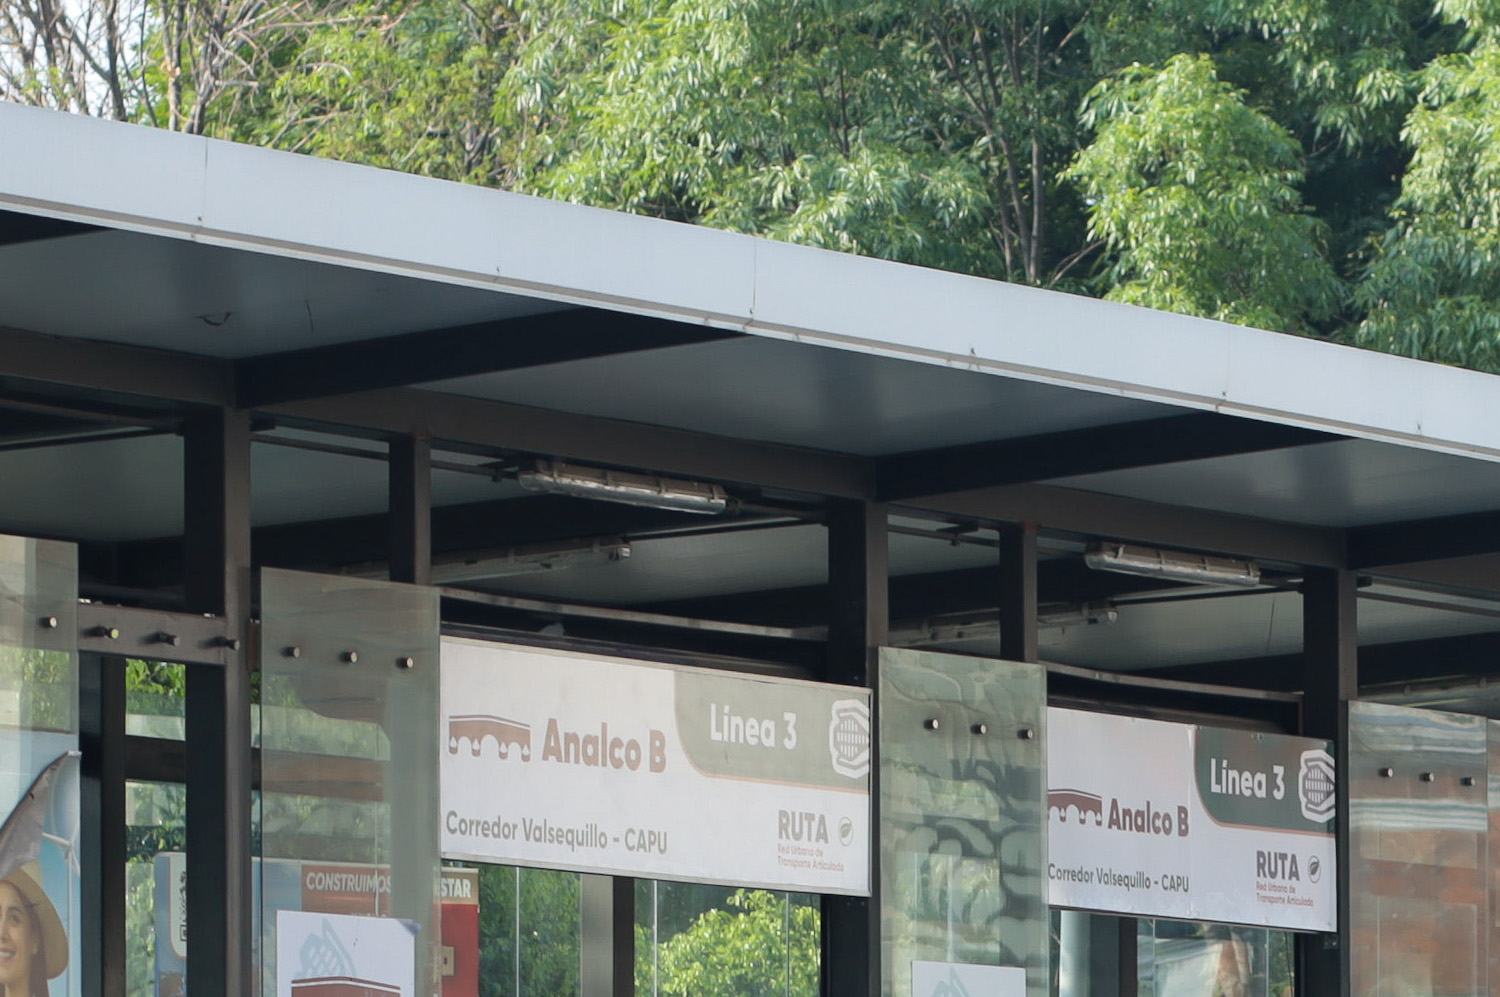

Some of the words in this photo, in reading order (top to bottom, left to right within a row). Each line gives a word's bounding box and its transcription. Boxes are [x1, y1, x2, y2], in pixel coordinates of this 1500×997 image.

[541, 718, 642, 771] Analco
[649, 729, 667, 773] B
[710, 703, 776, 748] Línea
[783, 711, 797, 749] 3
[1210, 757, 1267, 798] Línea
[1272, 764, 1285, 800] 3
[446, 809, 518, 840] Corredor
[522, 817, 608, 852] Valsequillo
[625, 827, 668, 854] CAPU
[778, 809, 829, 844] RUTA
[1107, 798, 1173, 836] Analco
[1177, 805, 1189, 837] B
[306, 872, 391, 894] CONSTRUIMOS
[435, 878, 471, 898] STAR
[1047, 863, 1094, 884] Corredor
[1096, 866, 1151, 892] Valsequillo
[1161, 874, 1189, 893] CAPU
[1256, 850, 1300, 881] RUTA
